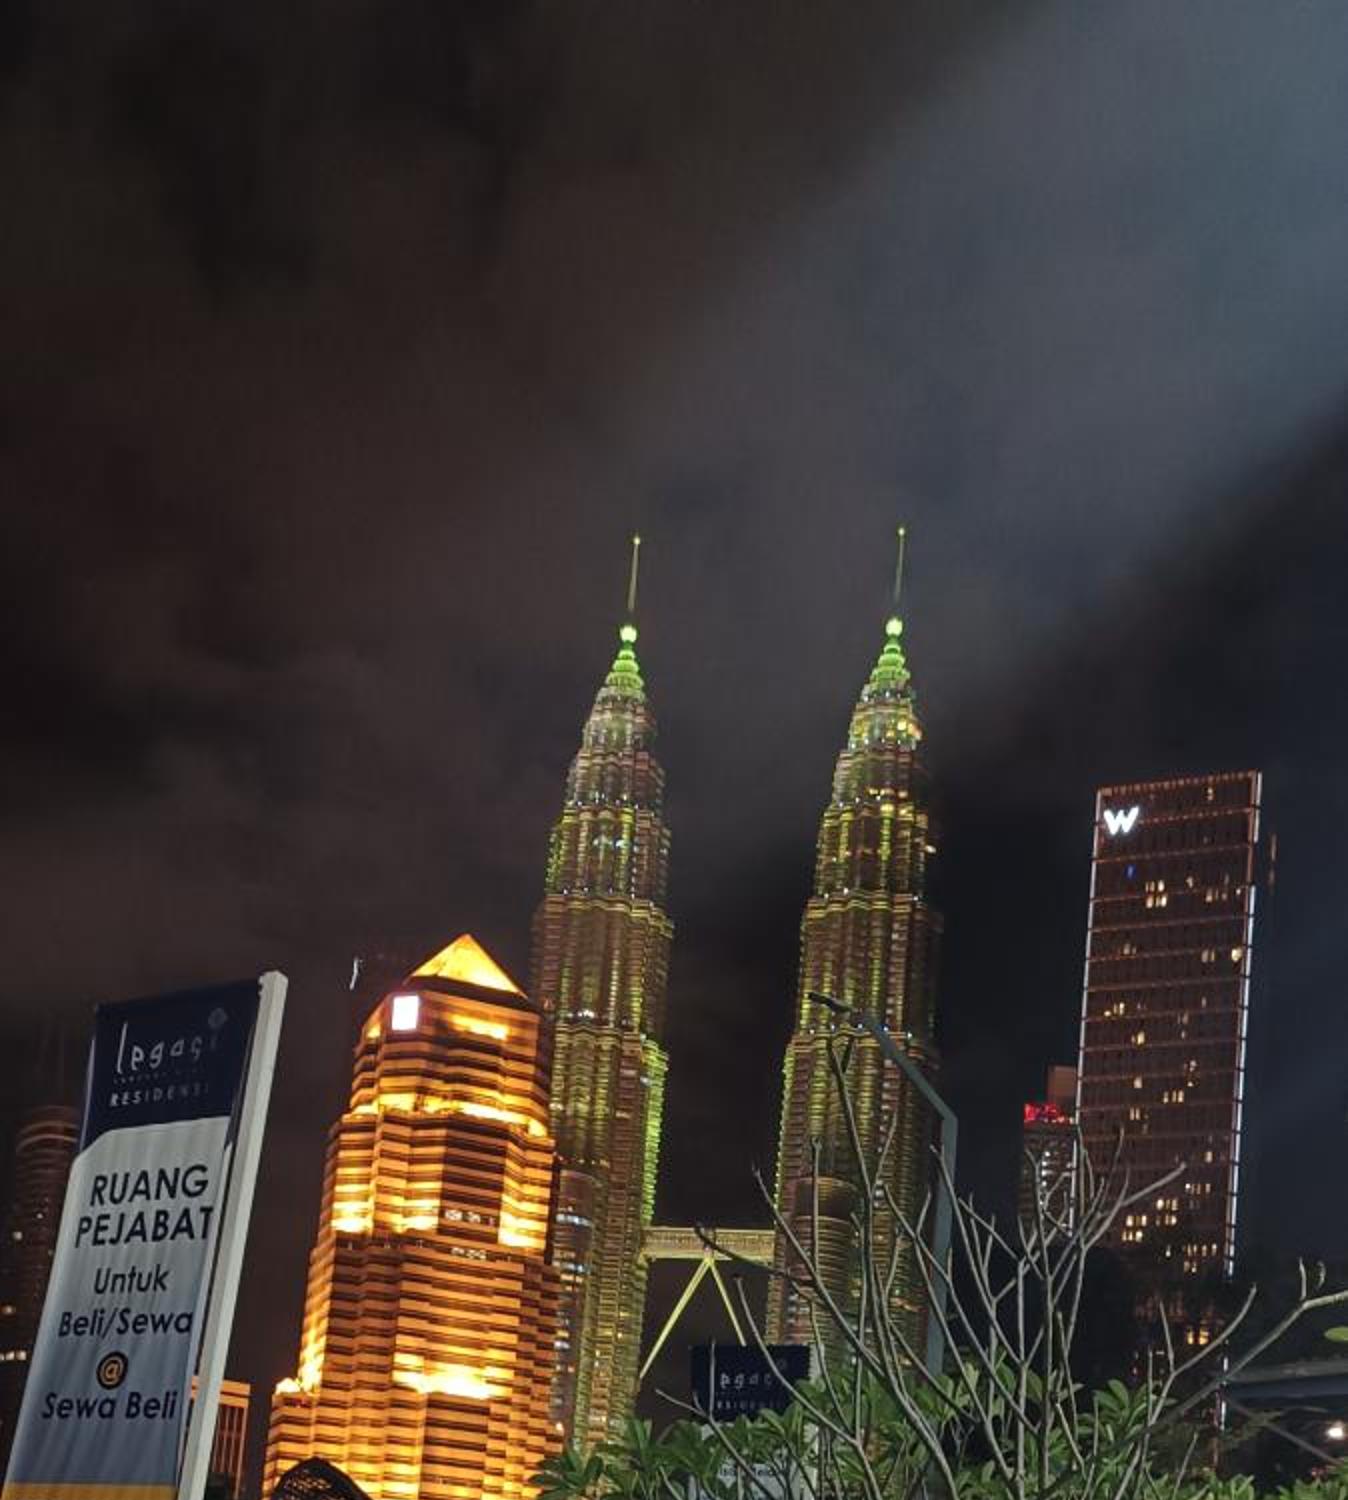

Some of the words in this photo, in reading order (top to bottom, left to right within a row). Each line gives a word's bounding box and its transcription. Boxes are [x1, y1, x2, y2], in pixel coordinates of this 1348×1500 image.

[1103, 806, 1139, 835] W
[90, 1164, 209, 1206] RUANG
[75, 1206, 213, 1248] PEJABAT
[94, 1264, 169, 1294] Untuk
[58, 1307, 193, 1340] Beli/Sewa
[99, 1354, 126, 1387] @
[42, 1392, 117, 1420] Sewa
[125, 1391, 178, 1419] Beli
